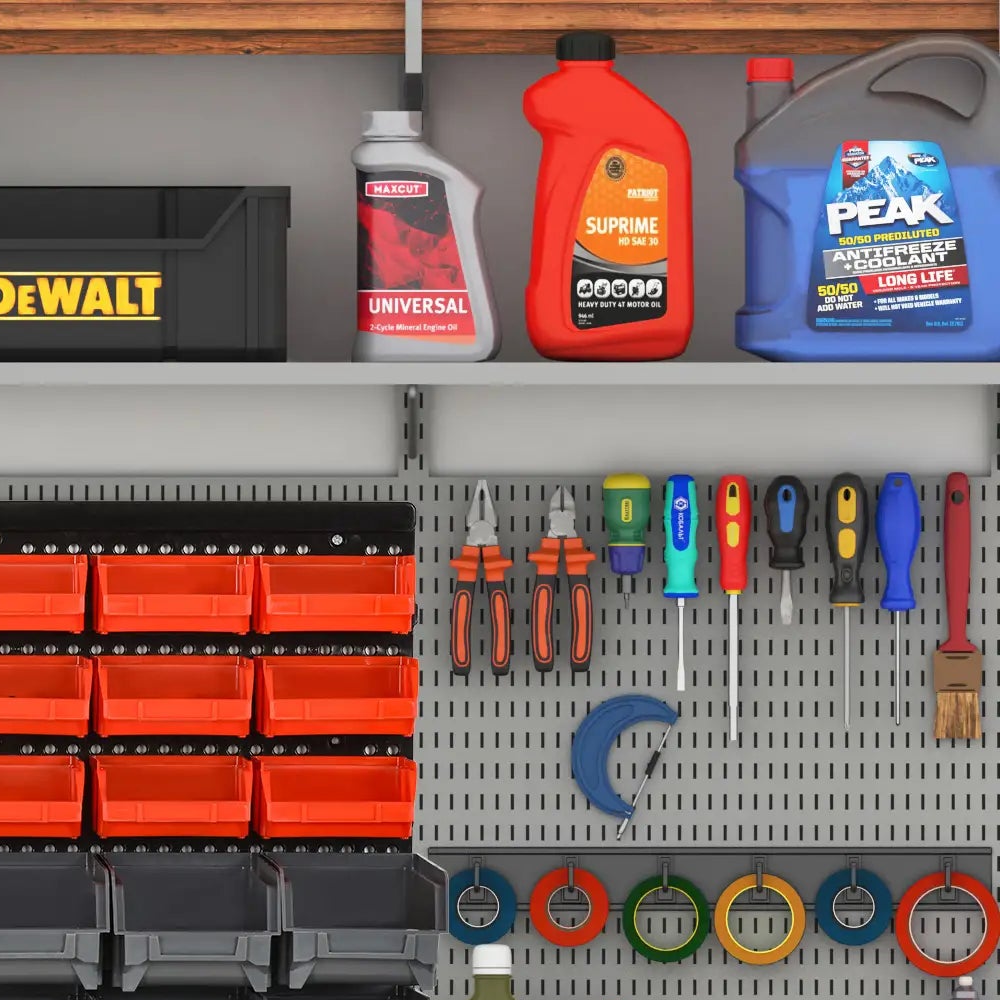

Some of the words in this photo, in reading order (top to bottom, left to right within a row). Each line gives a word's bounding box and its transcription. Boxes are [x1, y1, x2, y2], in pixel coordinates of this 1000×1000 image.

[374, 185, 420, 194] MAXCUT
[826, 193, 954, 234] PEAK
[586, 216, 658, 234] SUPRIME
[618, 236, 630, 246] HD
[632, 236, 646, 246] SAE
[648, 236, 658, 246] 30
[838, 234, 872, 246] 50/50
[874, 228, 940, 243] PREDILUTED
[832, 240, 957, 262] ANTIFREEZE
[878, 273, 918, 288] LONG
[921, 270, 954, 284] LIFE
[818, 282, 858, 297] 50/50
[368, 298, 468, 314] UNIVERSAL
[817, 304, 835, 312] ADD
[836, 300, 863, 310] WATER
[824, 296, 836, 304] DO
[837, 294, 854, 302] NOT
[370, 323, 394, 332] 2-Cycle
[423, 323, 446, 332] Engine
[448, 323, 458, 331] Oil
